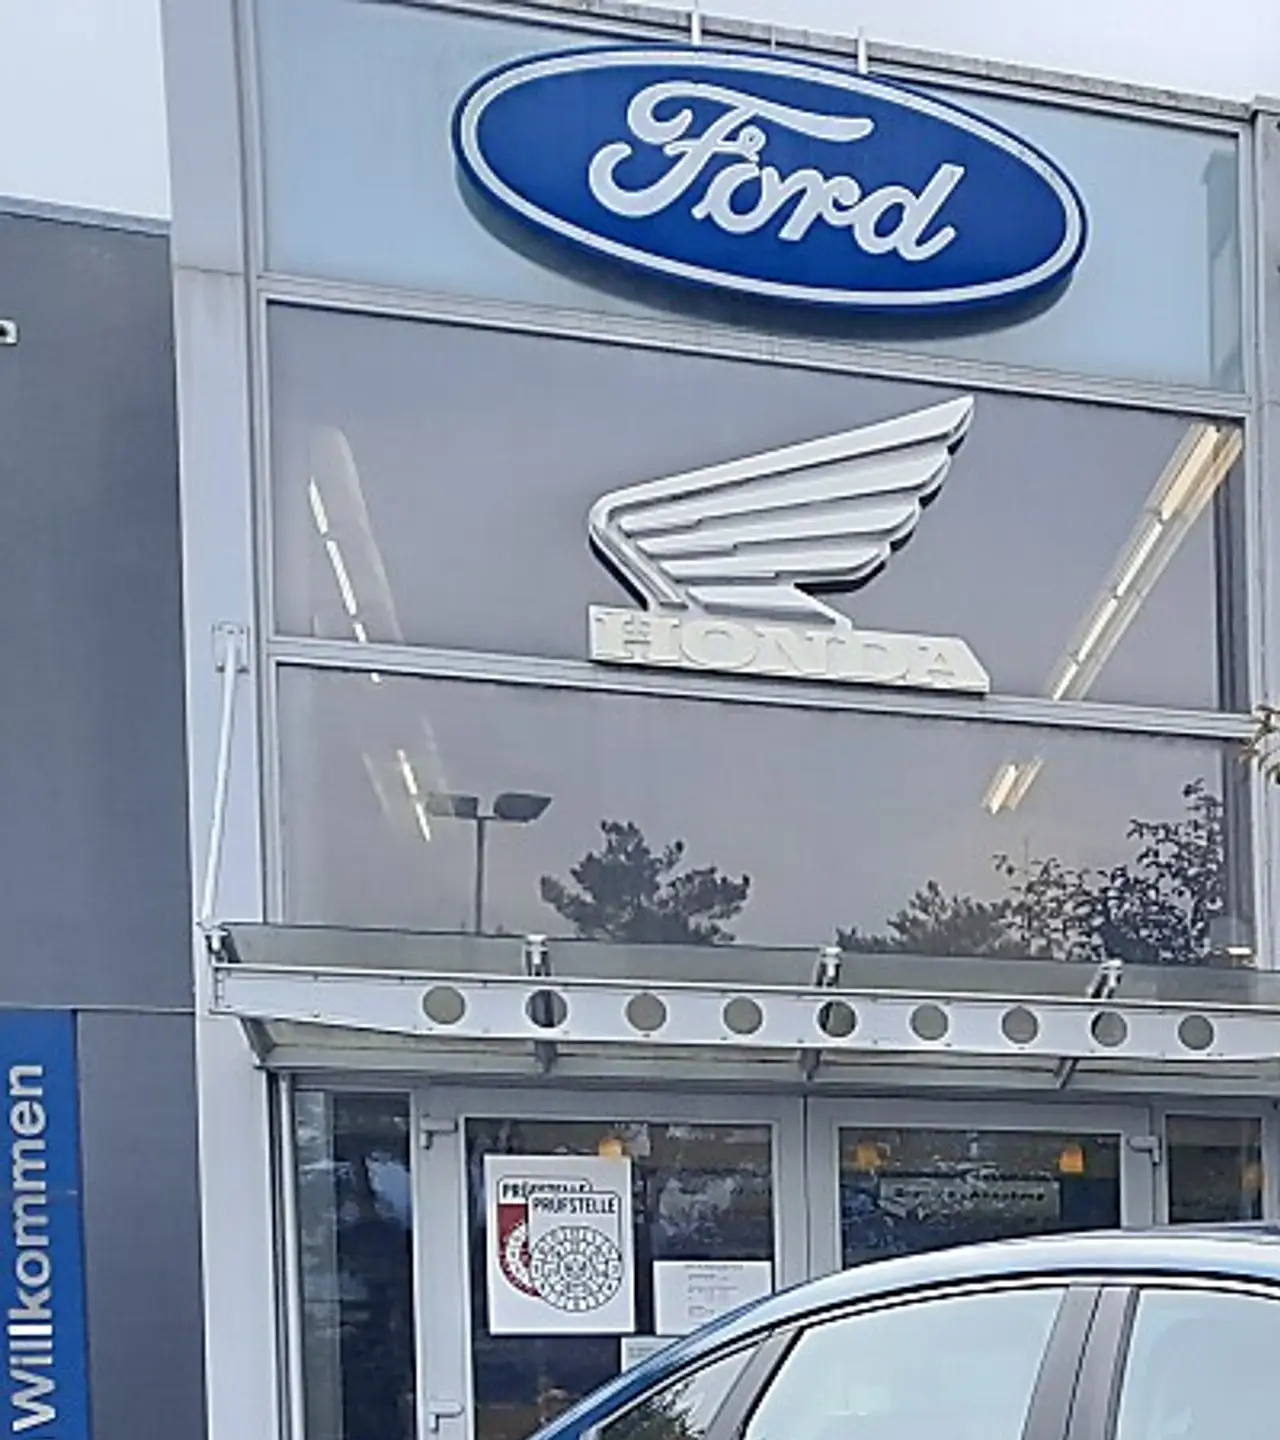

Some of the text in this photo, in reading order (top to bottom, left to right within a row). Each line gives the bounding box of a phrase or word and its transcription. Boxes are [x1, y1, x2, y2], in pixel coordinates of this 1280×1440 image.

[589, 80, 965, 261] Ford
[594, 609, 987, 693] HONDA
[7, 1064, 56, 1431] Willkommen
